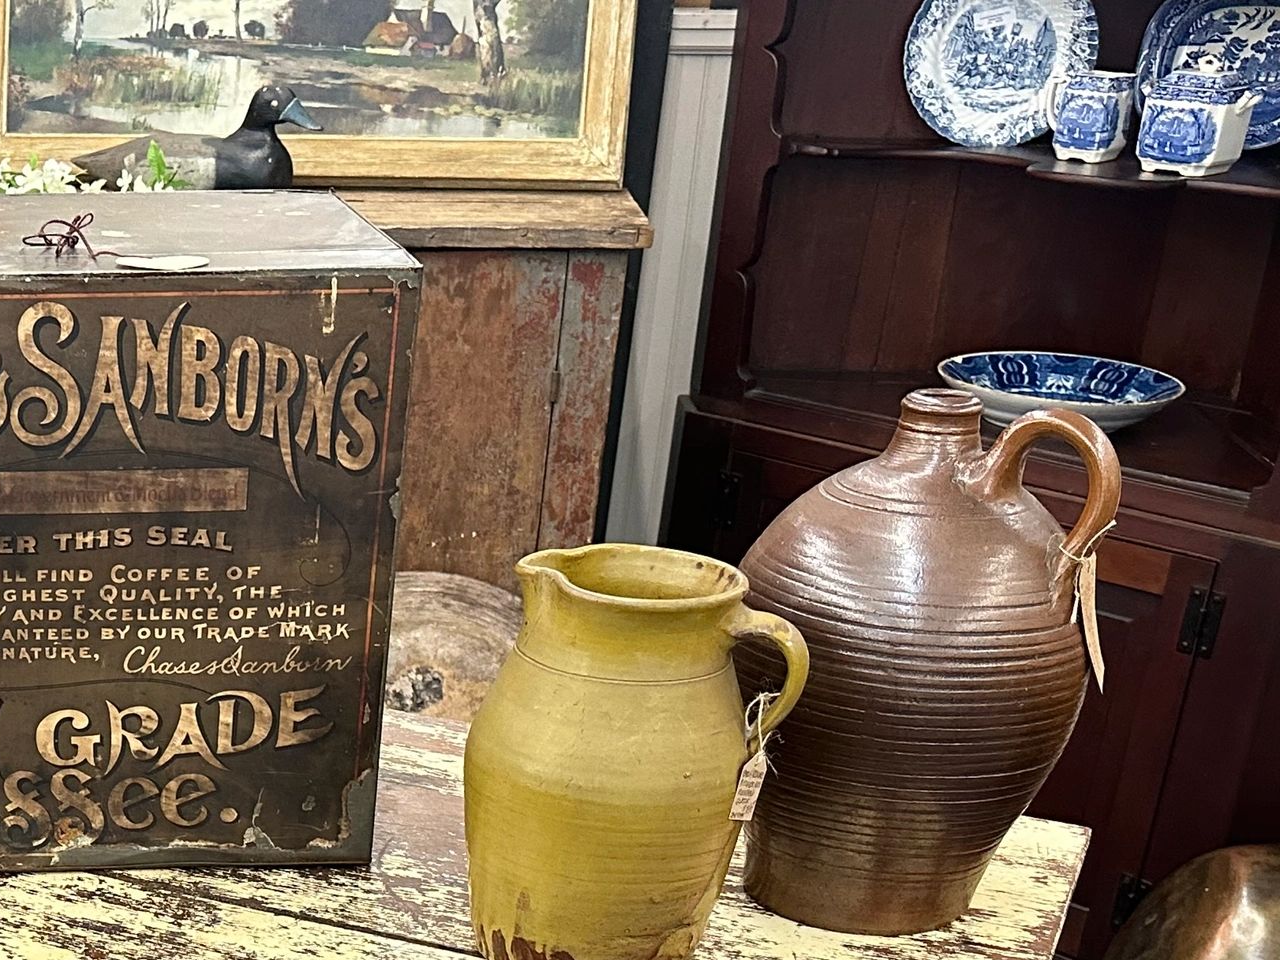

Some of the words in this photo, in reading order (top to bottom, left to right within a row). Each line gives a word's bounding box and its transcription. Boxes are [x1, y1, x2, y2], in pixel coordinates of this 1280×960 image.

[10, 299, 382, 503] SANBORN'S
[52, 527, 133, 552] THIS
[146, 525, 233, 552] SEAL
[36, 569, 94, 583] FIND
[110, 563, 210, 584] COFFEE
[226, 565, 261, 581] OF
[99, 582, 224, 604] QUALITY,
[232, 585, 283, 600] THE
[11, 607, 63, 625] AND
[73, 604, 219, 623] EXCELLENCE
[228, 607, 259, 620] OF
[267, 602, 347, 618] WHICH
[100, 624, 131, 640] BY
[136, 627, 186, 643] OUR
[192, 622, 271, 643] TRADE
[278, 621, 352, 642] MARK
[35, 684, 335, 777] GRADE
